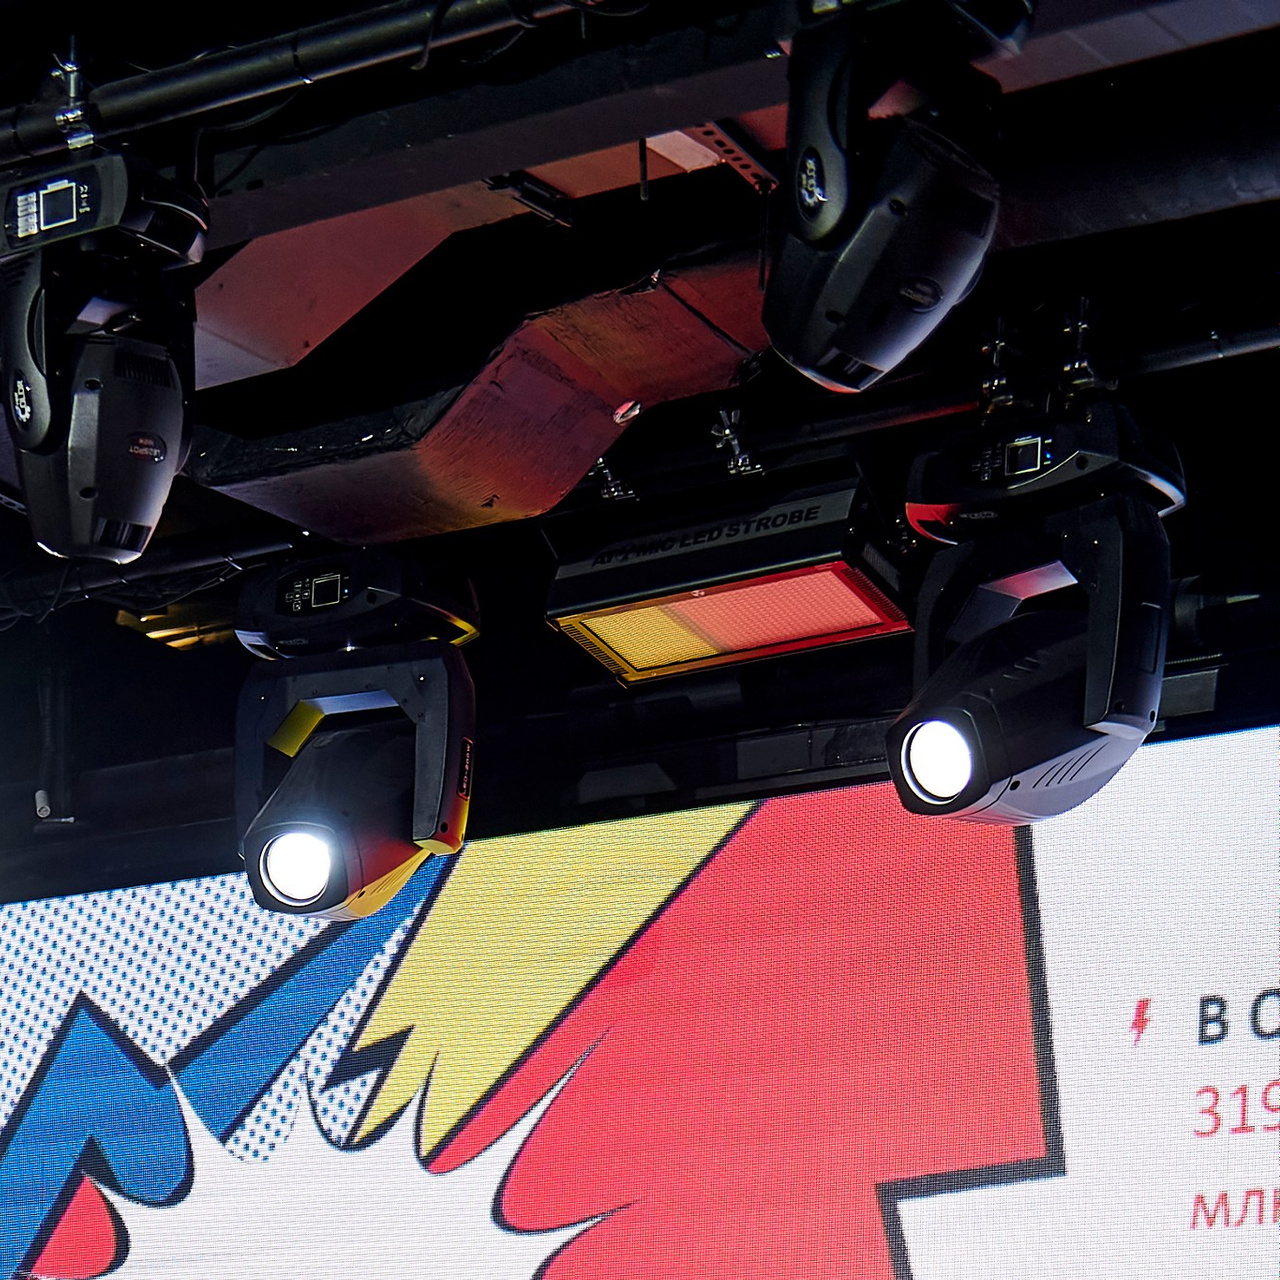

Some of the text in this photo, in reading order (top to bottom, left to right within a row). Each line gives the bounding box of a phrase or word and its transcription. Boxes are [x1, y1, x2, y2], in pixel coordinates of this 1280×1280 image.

[680, 526, 723, 549] LED
[725, 505, 821, 538] STROBE
[1190, 1187, 1280, 1230] мл
